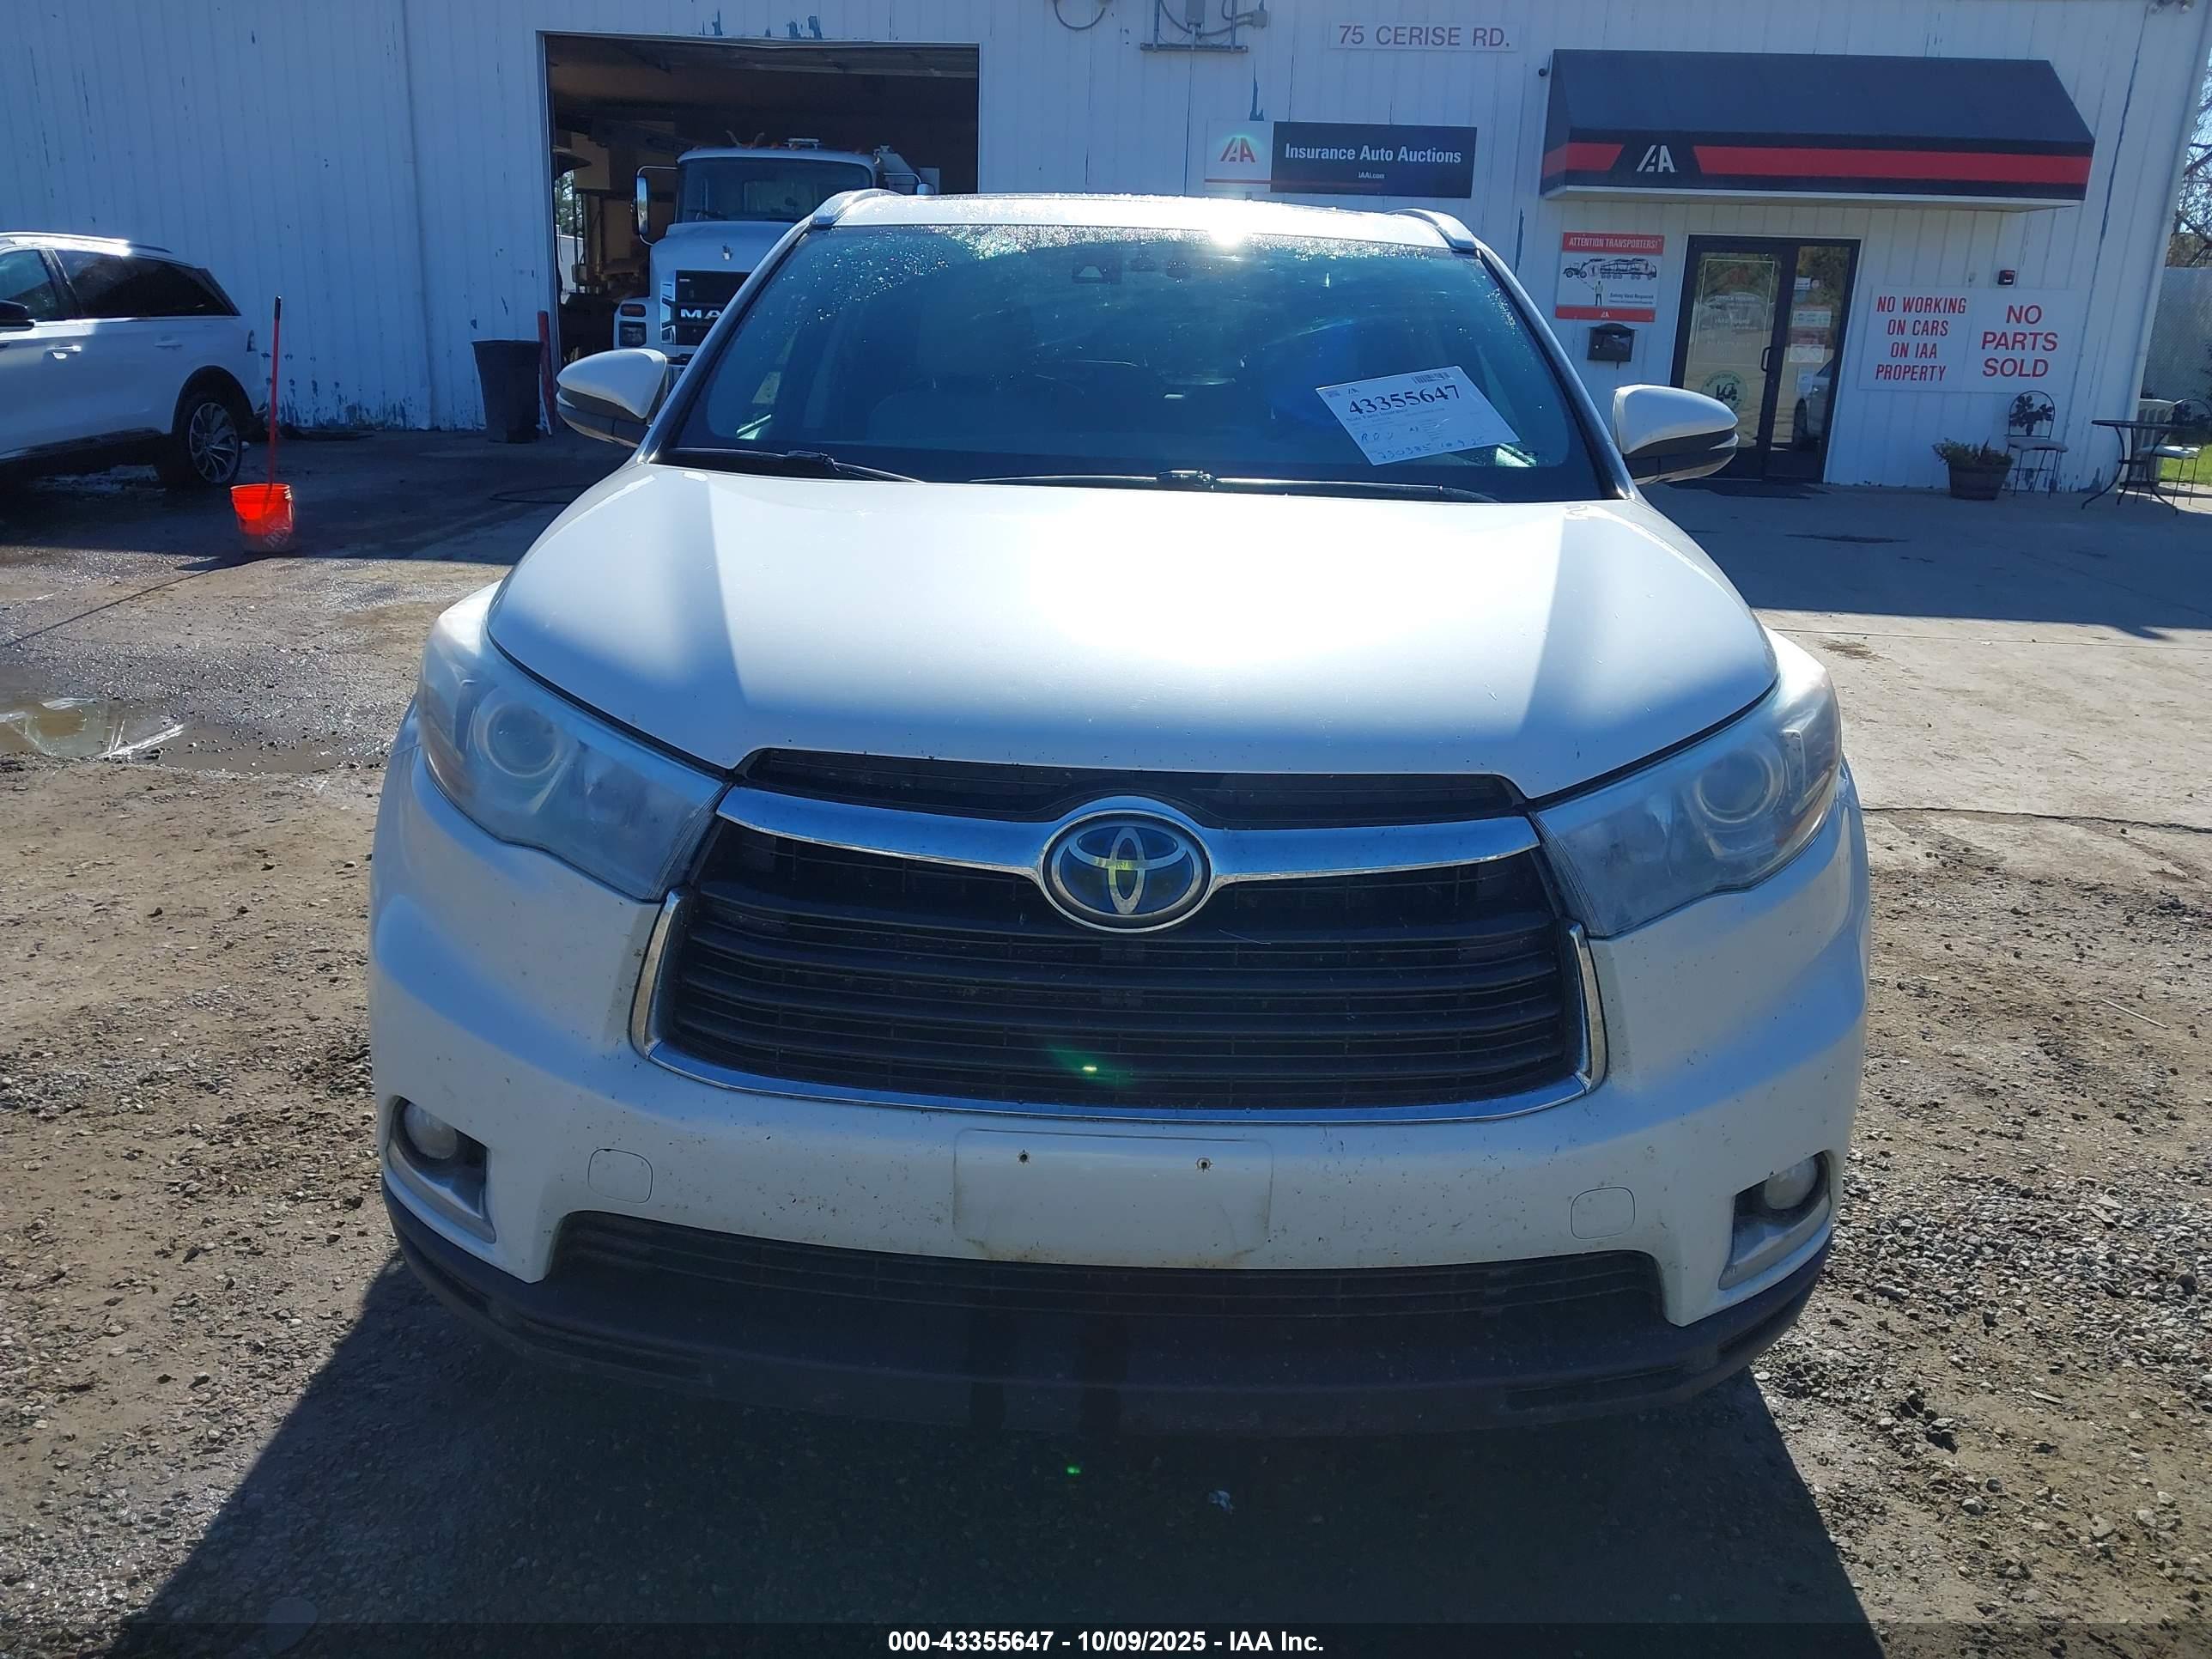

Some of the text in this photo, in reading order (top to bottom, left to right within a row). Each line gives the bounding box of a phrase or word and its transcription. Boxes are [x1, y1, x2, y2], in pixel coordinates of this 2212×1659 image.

[1339, 25, 1510, 46] 75 CERISE RD.
[1285, 143, 1462, 163] Insurance Auto Auctions
[1569, 236, 1604, 247] ATTENTION
[1876, 296, 1966, 314] NO WORKING
[2006, 305, 2042, 325] NO
[1887, 319, 1948, 337] ON CARS
[1890, 342, 1937, 359] ON IAA
[1981, 331, 2058, 352] PARTS
[1875, 364, 1946, 381] PROPERTY
[1982, 357, 2049, 378] SOLD
[1349, 385, 1460, 415] 43355647
